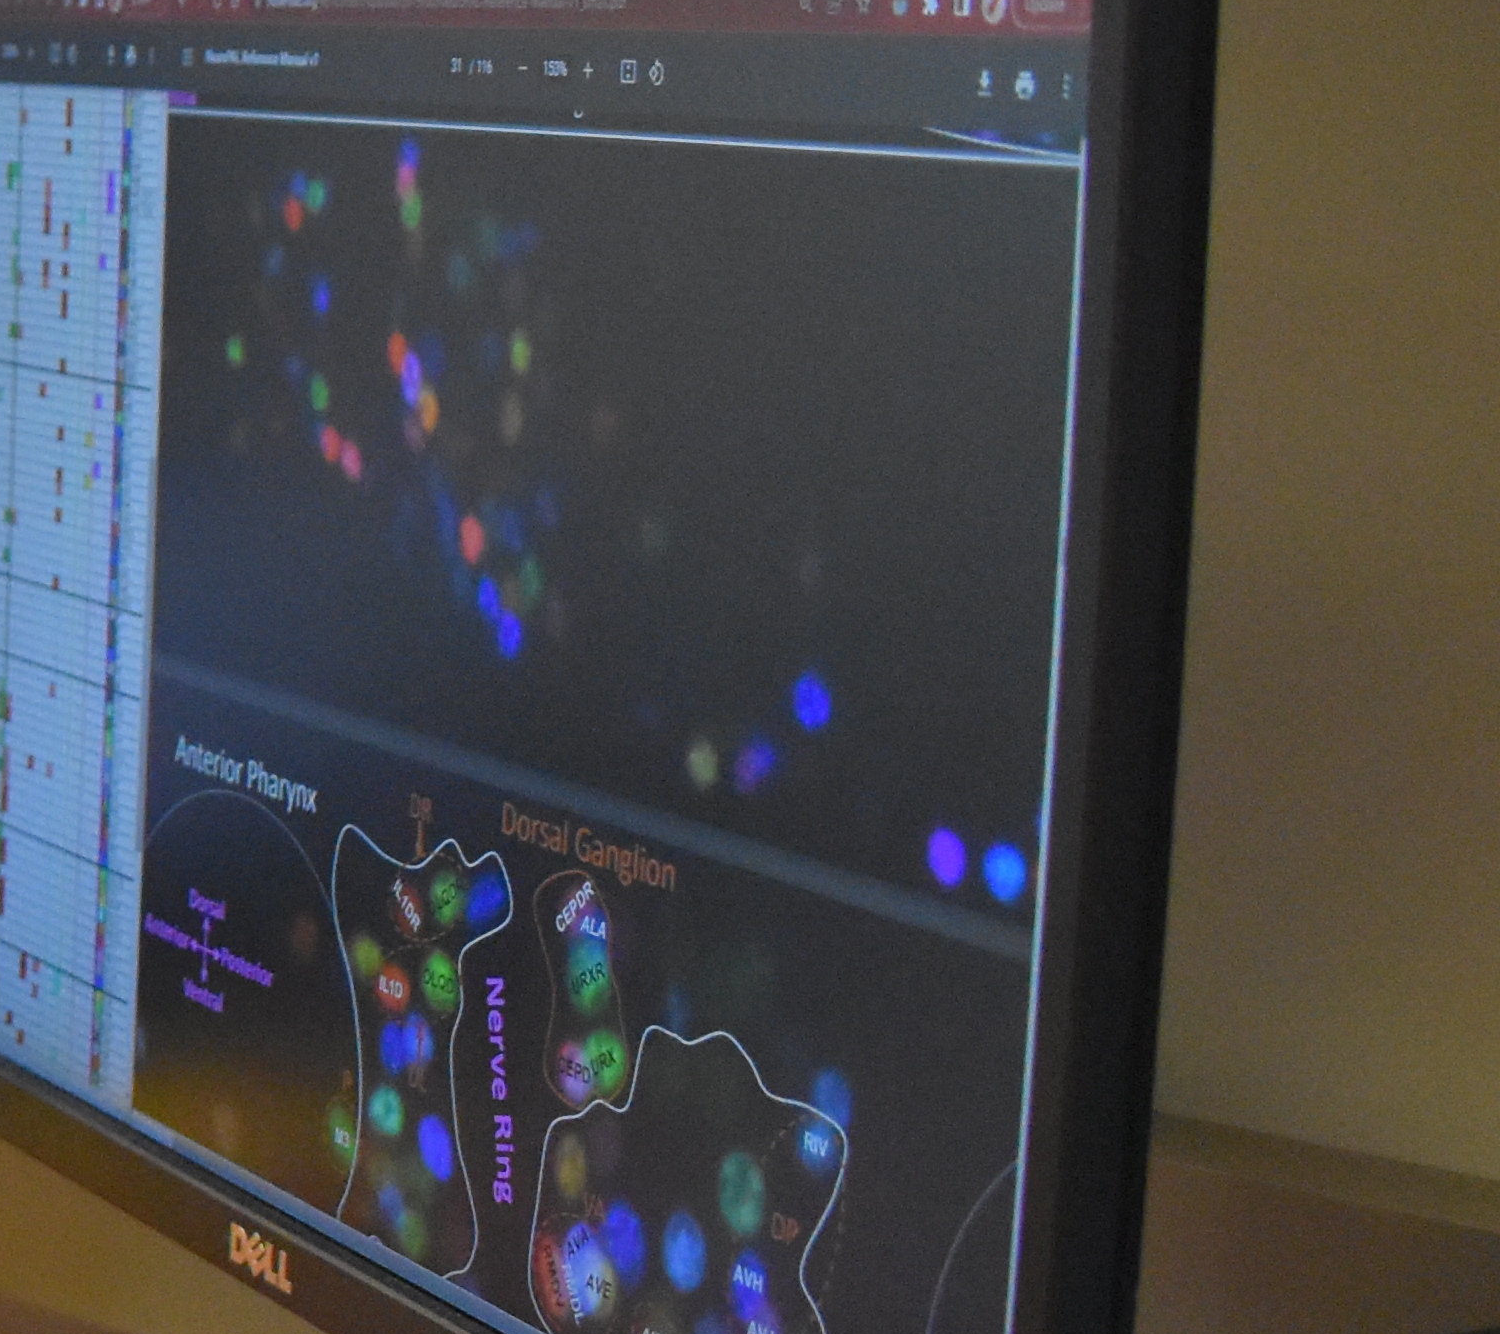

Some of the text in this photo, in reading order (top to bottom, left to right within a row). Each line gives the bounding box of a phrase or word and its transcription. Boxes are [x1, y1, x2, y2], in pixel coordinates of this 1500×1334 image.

[174, 735, 318, 814] Anterior Pharynx
[501, 801, 678, 892] Dorsal Ganglion
[555, 881, 595, 933] CEPDR
[580, 915, 607, 940] ALA
[484, 976, 516, 1205] Nerve Ring
[803, 1130, 829, 1158] RIV
[229, 1221, 294, 1296] DELL
[732, 1263, 764, 1294] AVH
